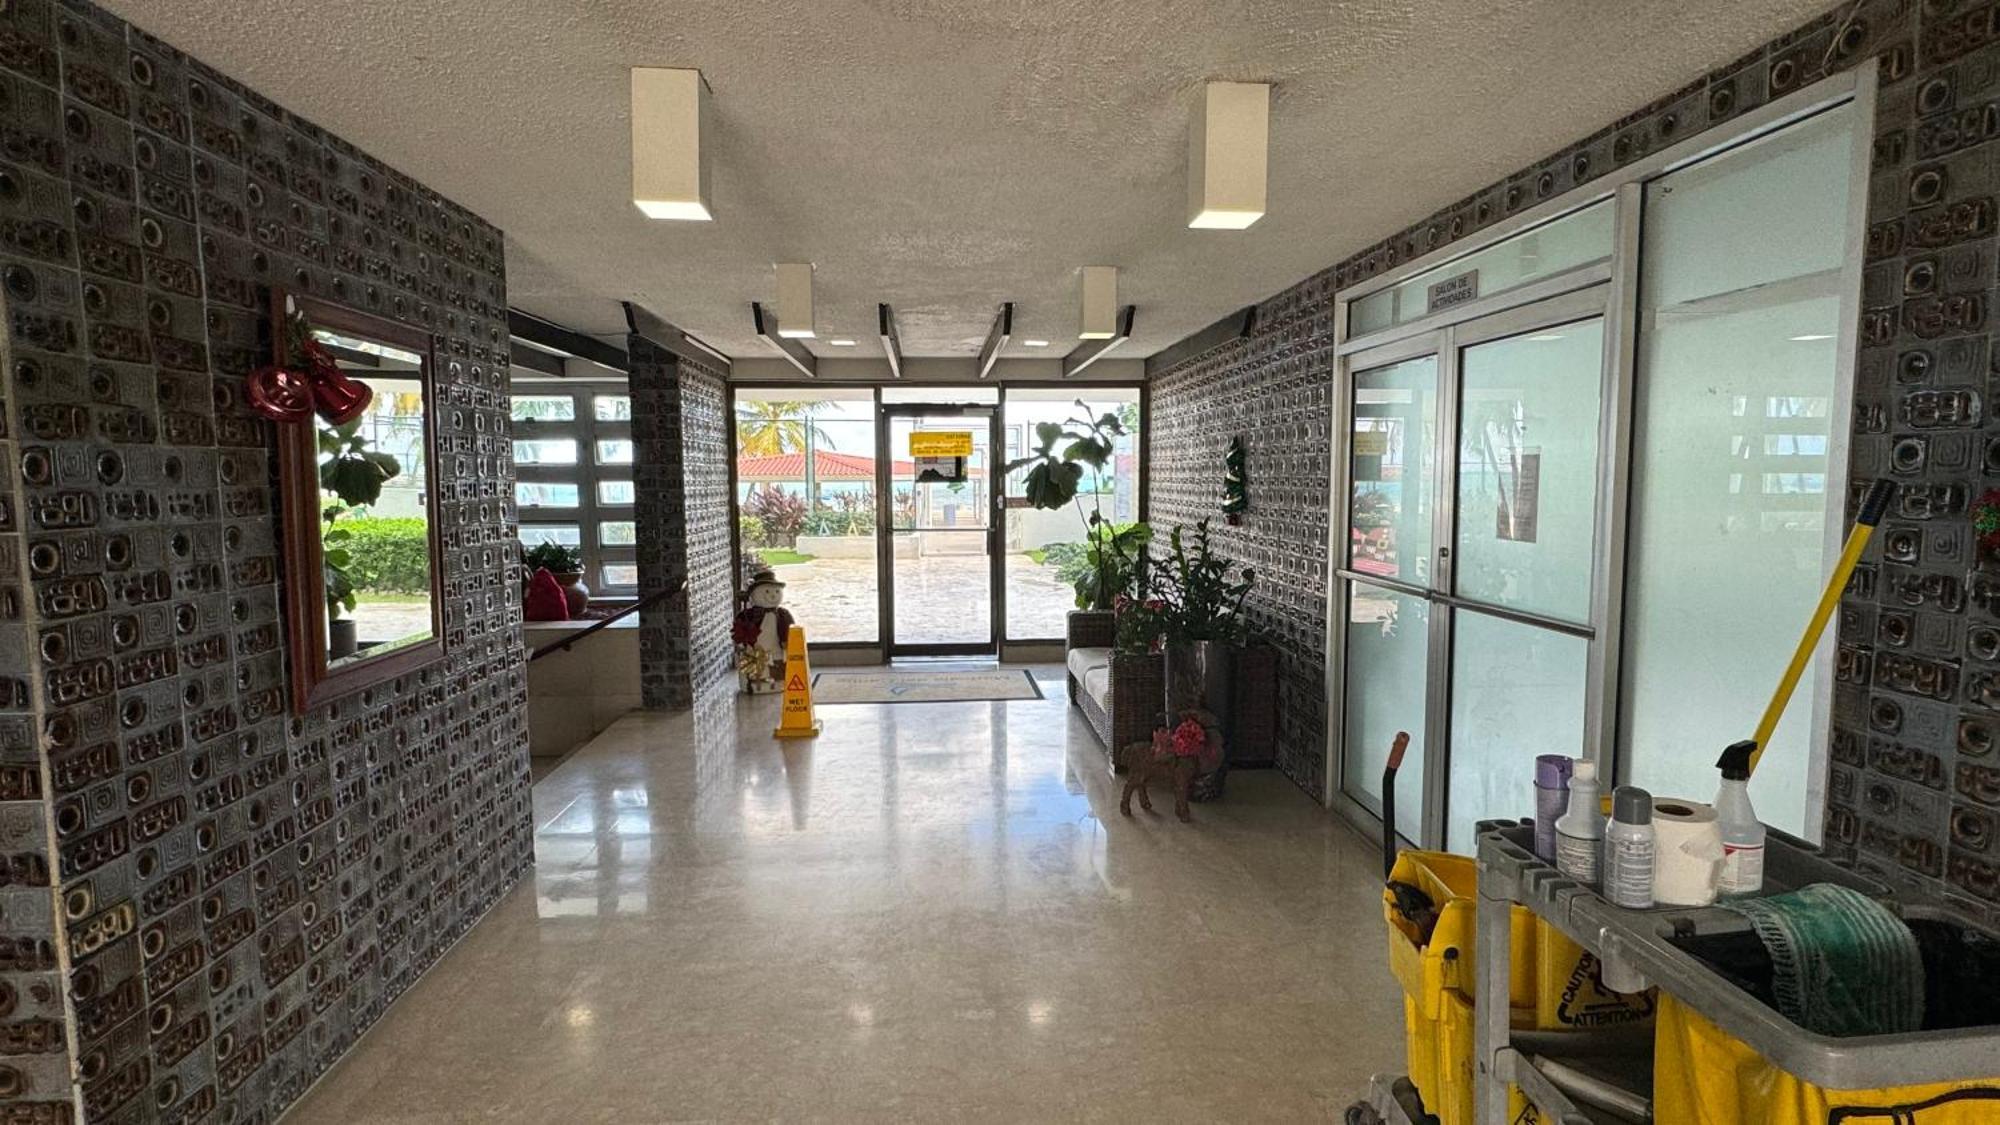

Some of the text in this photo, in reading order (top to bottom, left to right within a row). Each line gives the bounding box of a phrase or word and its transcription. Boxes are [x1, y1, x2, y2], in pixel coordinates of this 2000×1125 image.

[1459, 276, 1468, 289] DE
[1432, 288, 1472, 309] ACTIVIDADES
[1574, 1009, 1641, 1026] ATTENTION
